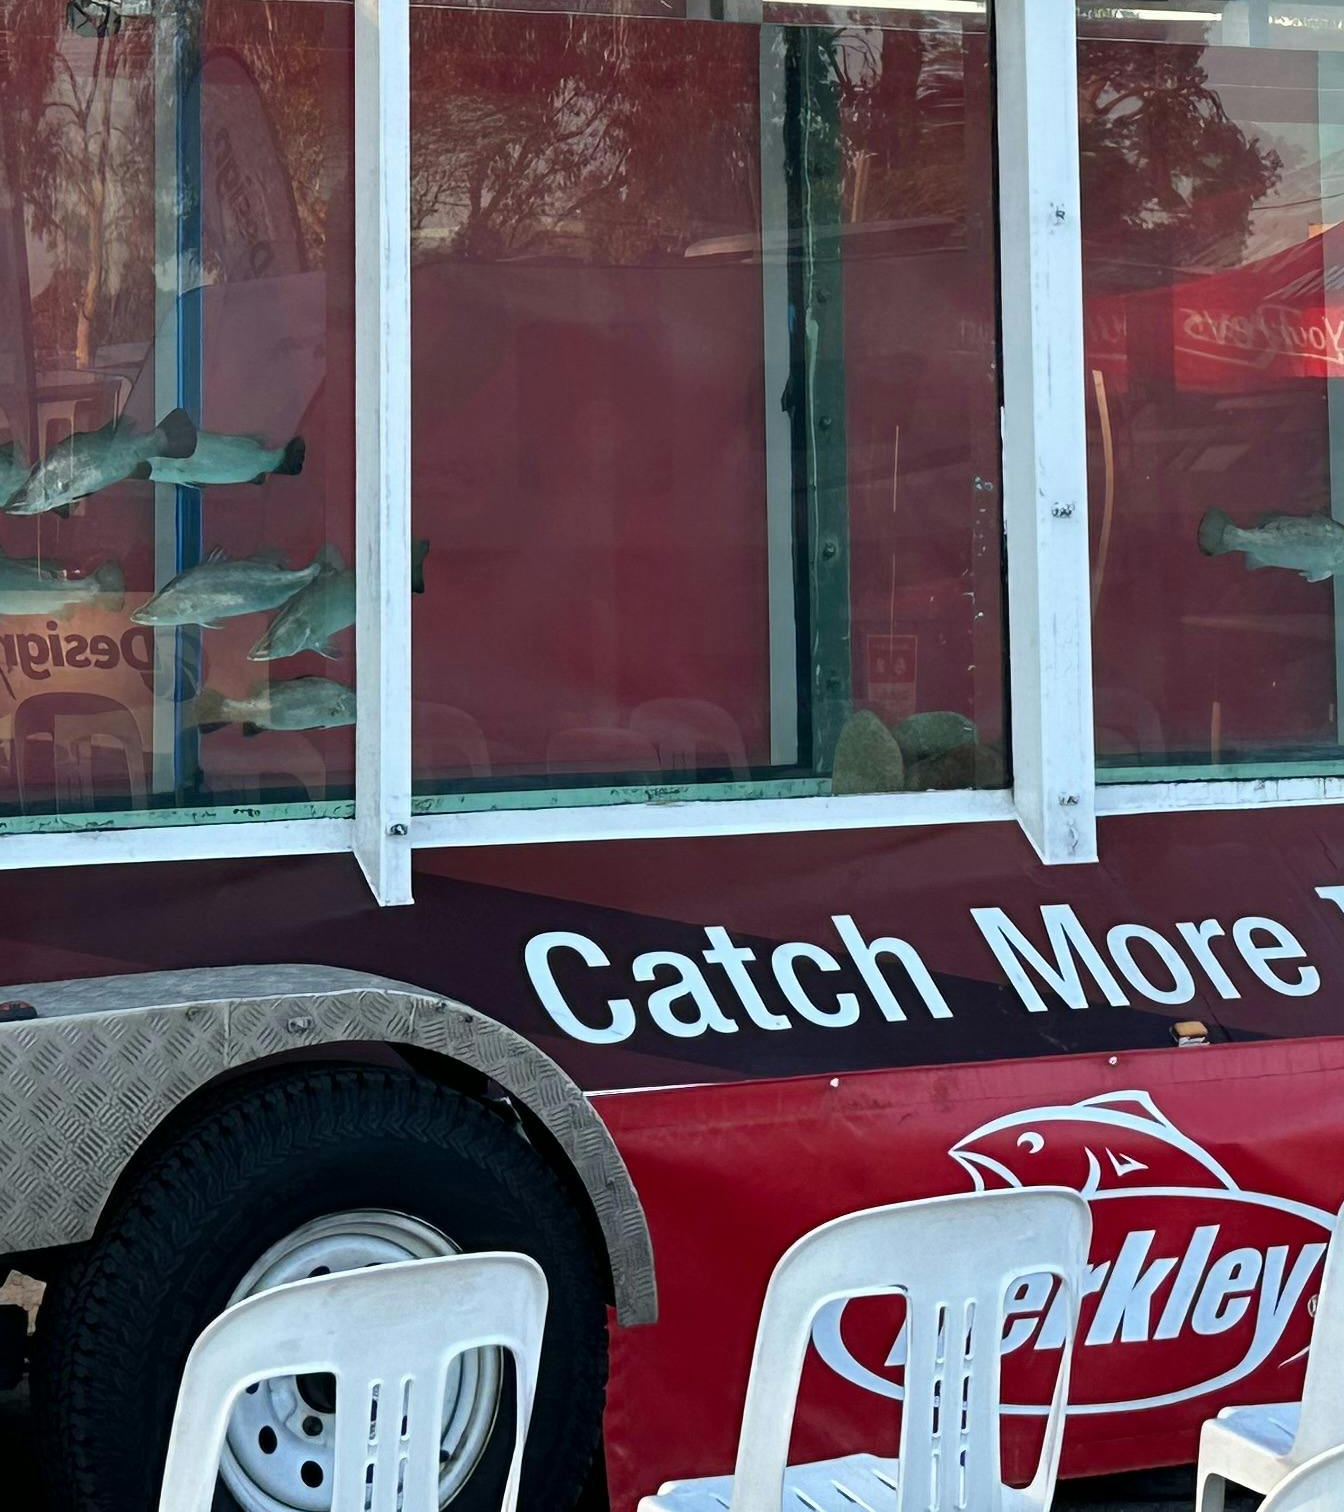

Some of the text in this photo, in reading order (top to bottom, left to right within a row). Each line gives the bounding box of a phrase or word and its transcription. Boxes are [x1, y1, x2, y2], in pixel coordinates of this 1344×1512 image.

[523, 914, 953, 1045] Catch
[970, 903, 1322, 1010] More
[885, 1224, 1327, 1383] erkley
